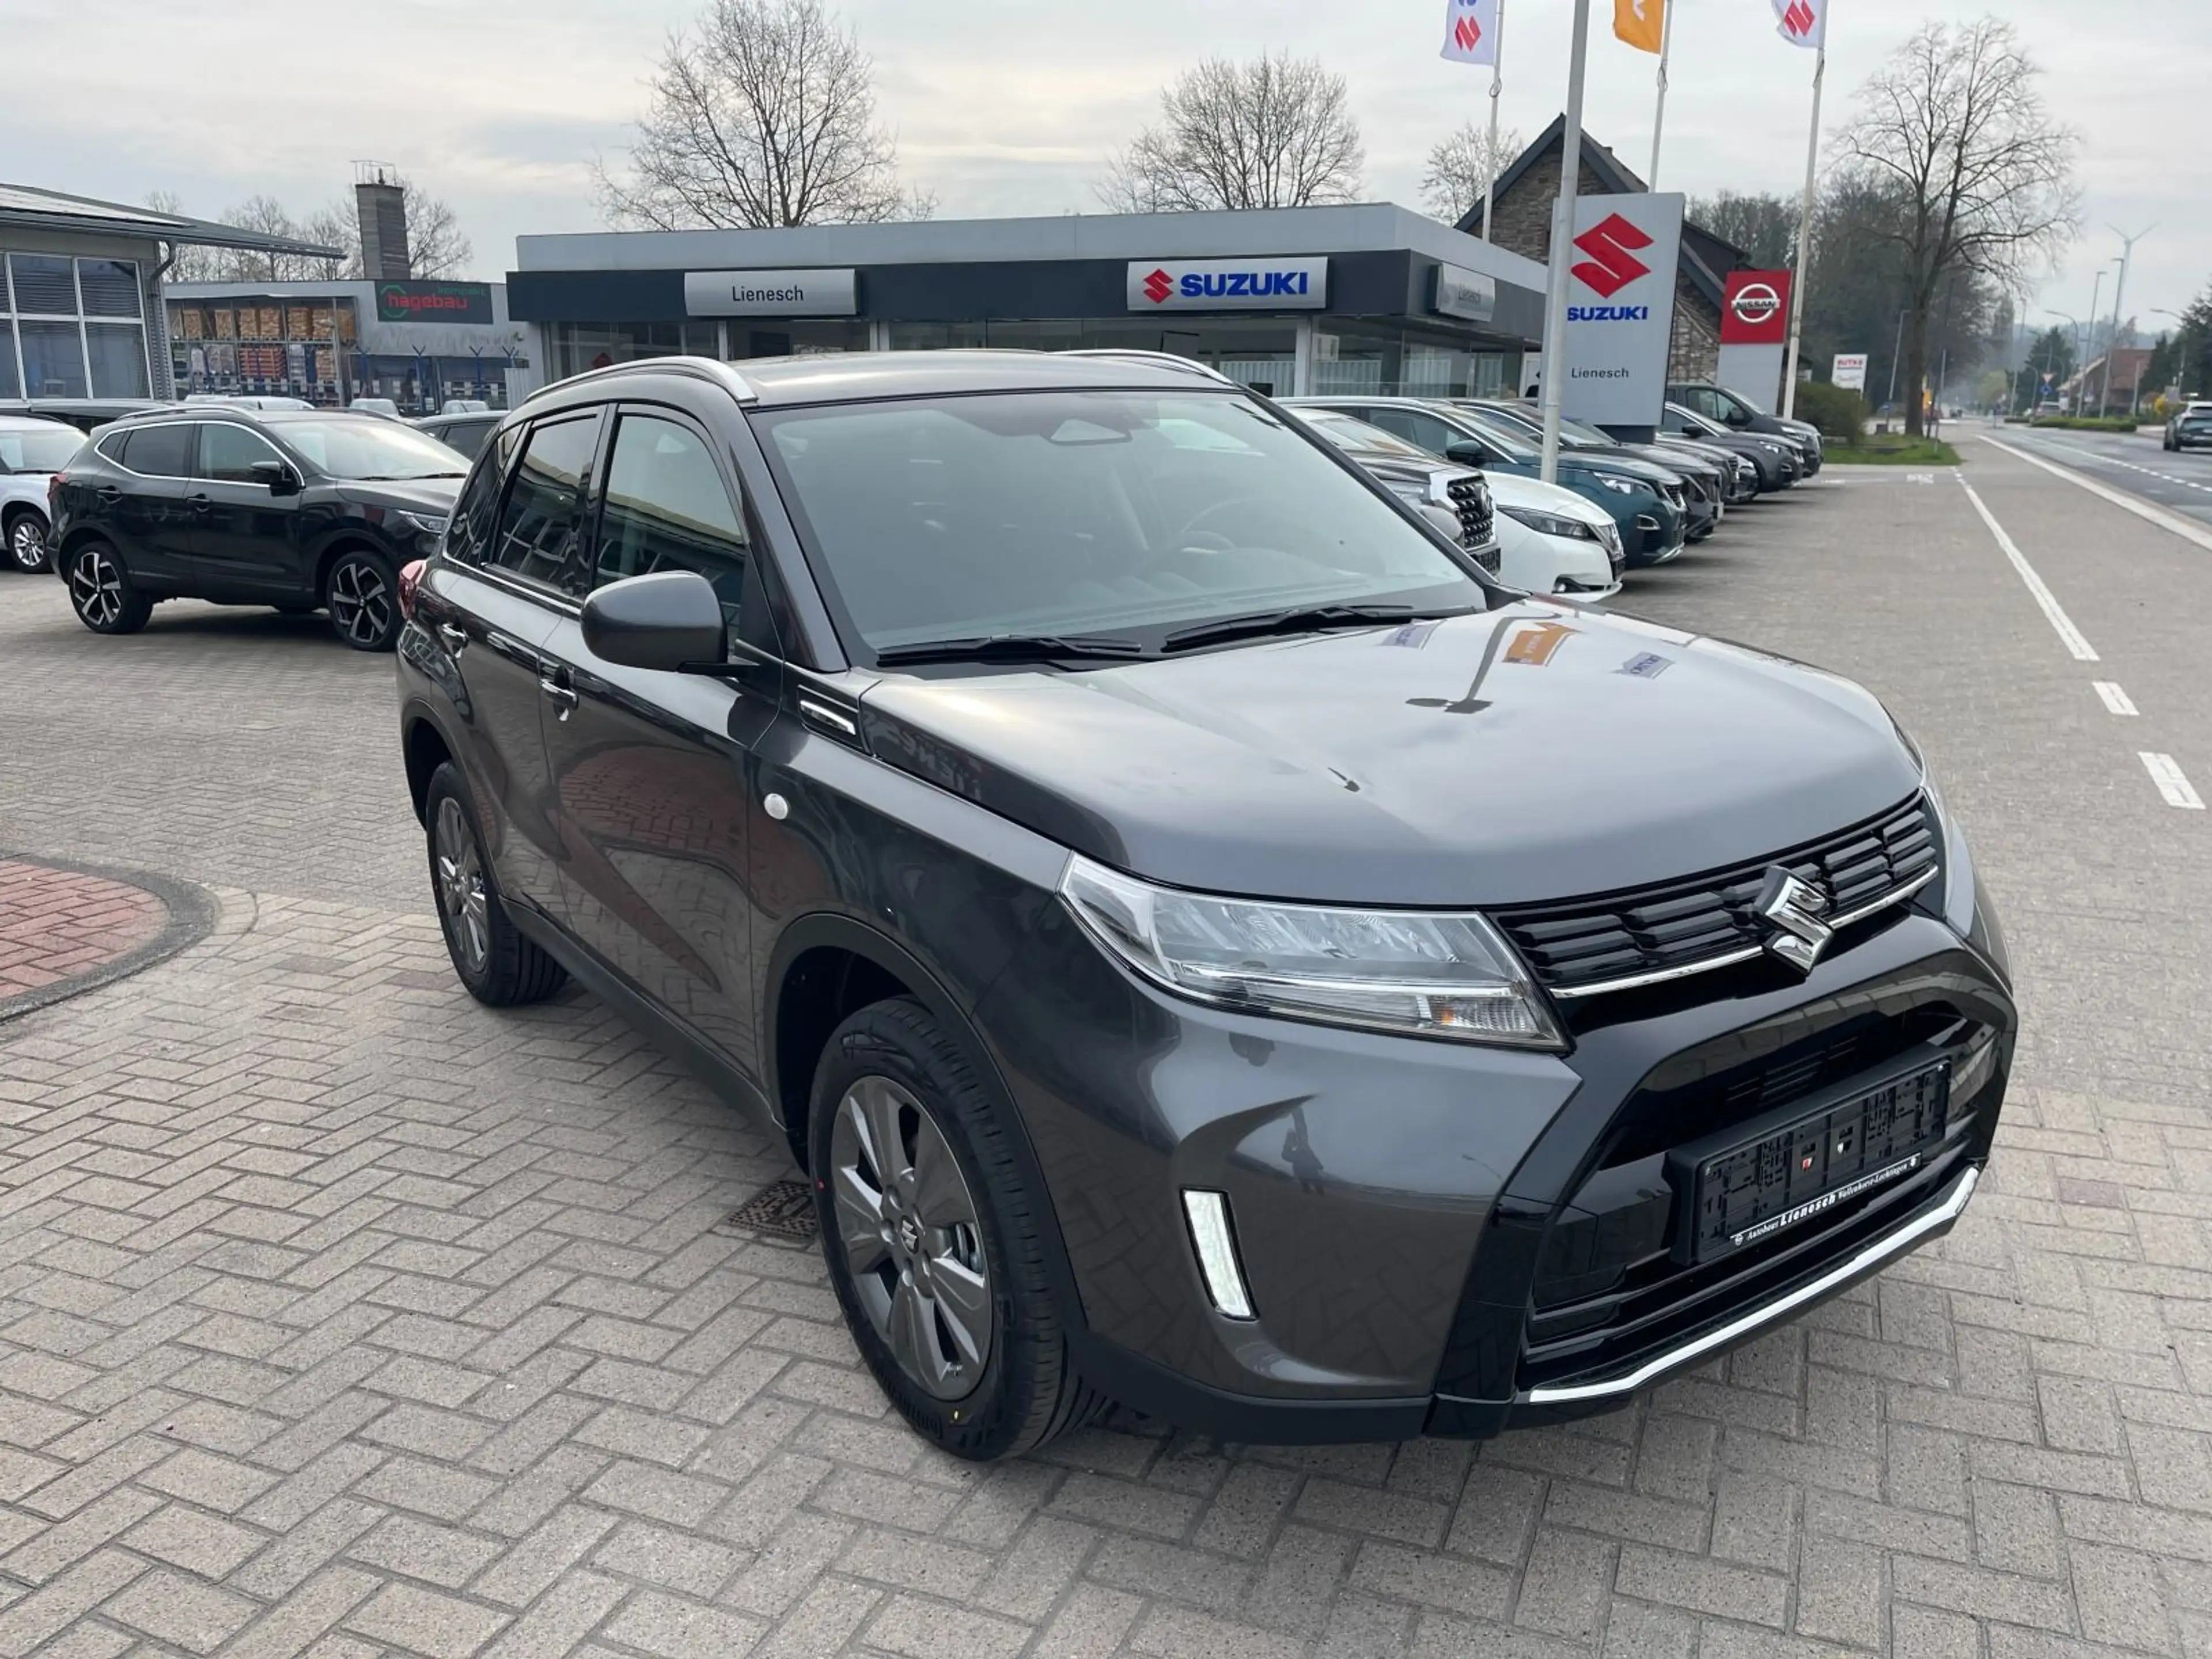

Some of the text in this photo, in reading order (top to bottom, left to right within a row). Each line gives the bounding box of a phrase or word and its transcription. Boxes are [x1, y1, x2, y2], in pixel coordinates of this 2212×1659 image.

[1180, 272, 1308, 297] SUZUKI
[732, 285, 804, 301] Lienesch
[388, 293, 468, 311] hagebau
[1736, 301, 1775, 310] NISSAN
[1567, 306, 1648, 321] SUZUKI
[1571, 367, 1630, 378] Lienesch
[1781, 1194, 1836, 1226] Lienesch
